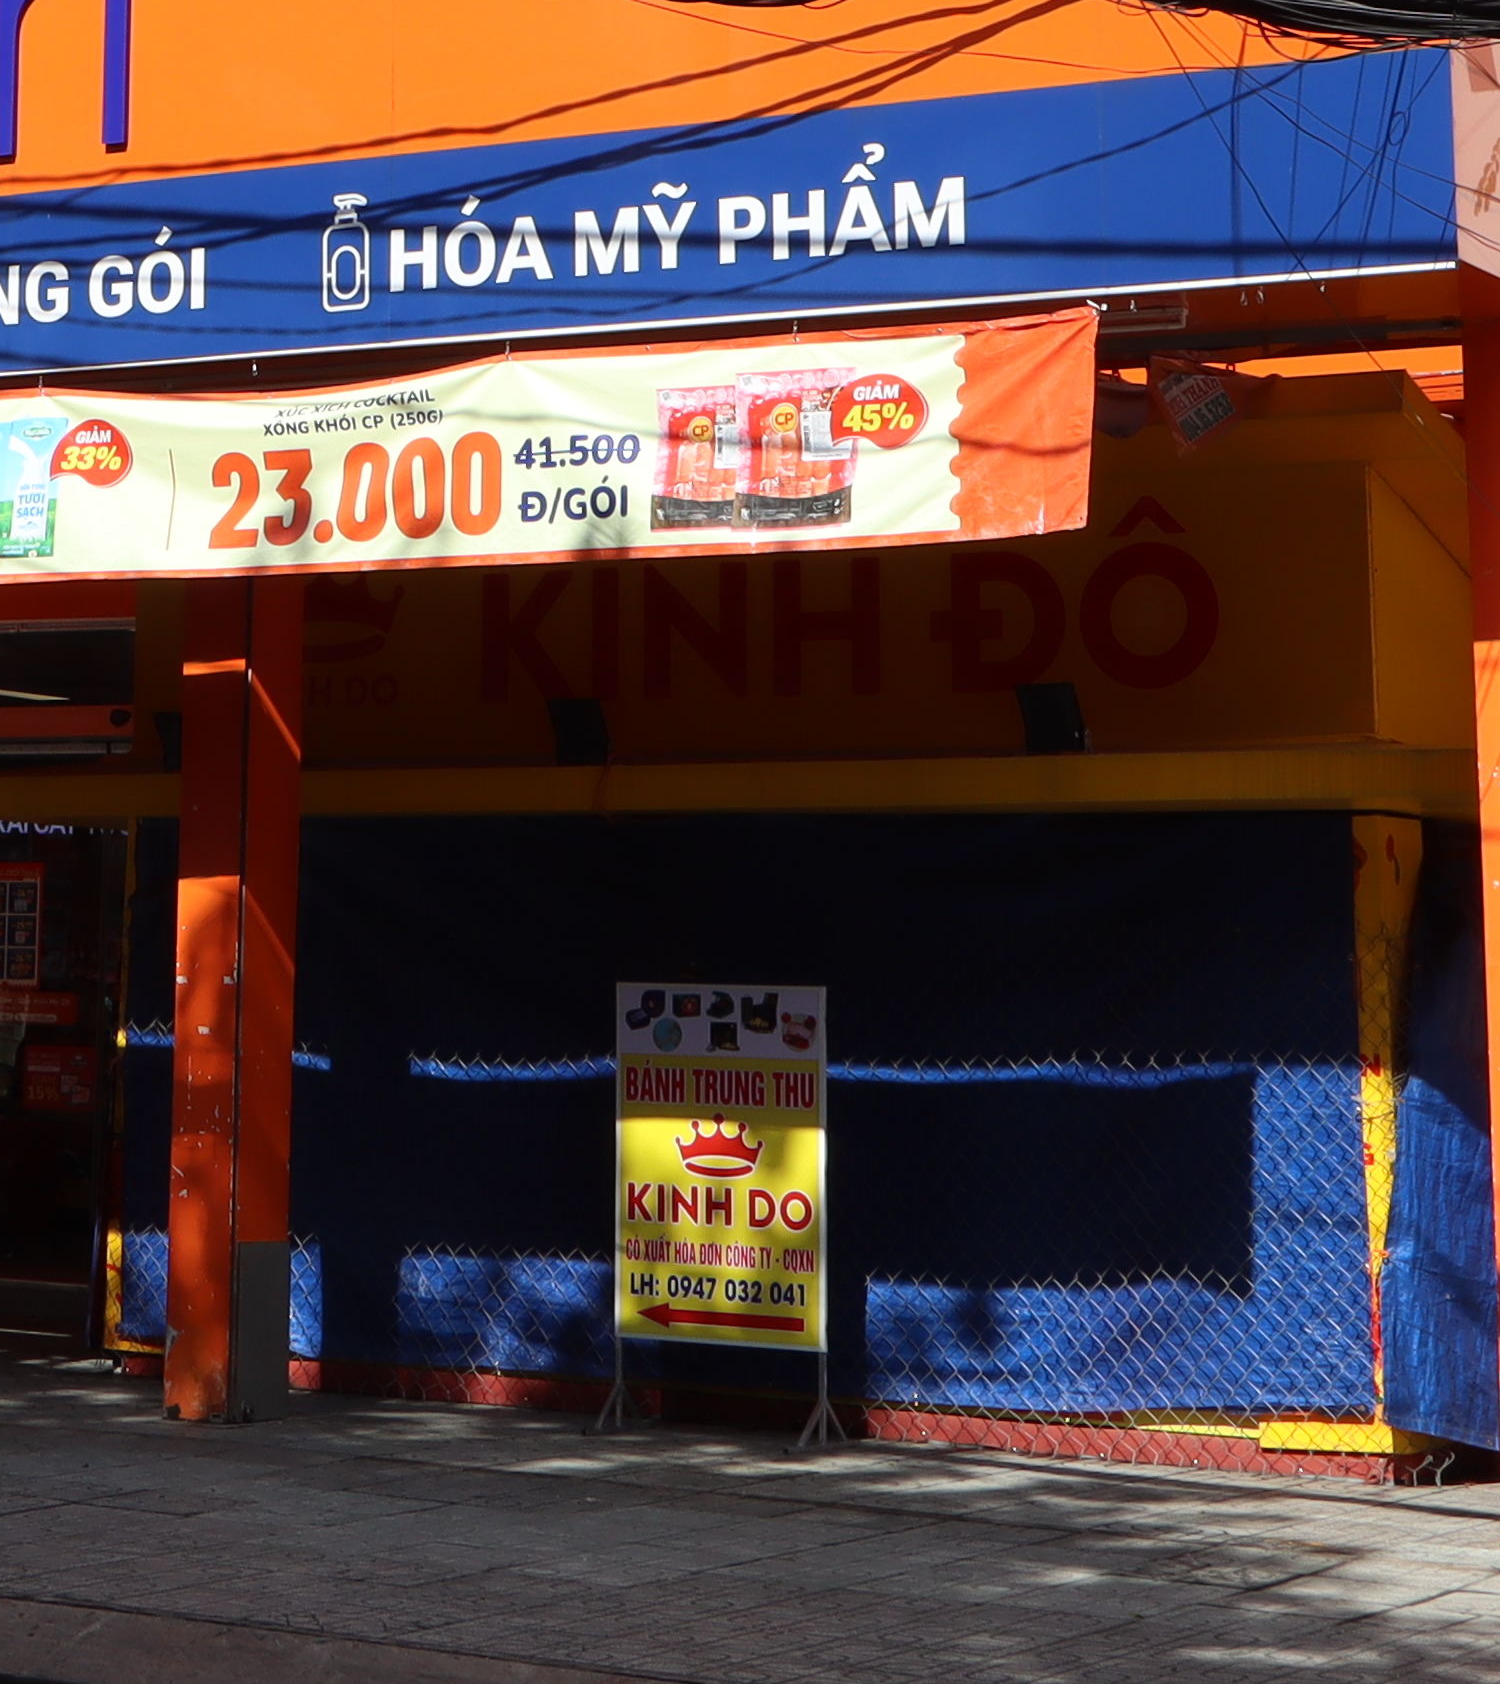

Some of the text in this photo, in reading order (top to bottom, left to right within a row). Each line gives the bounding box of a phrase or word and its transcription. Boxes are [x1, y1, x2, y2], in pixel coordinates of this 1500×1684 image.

[388, 143, 967, 293] HÓA MỸ PHẨM
[87, 224, 206, 319] GÓI
[852, 379, 901, 403] GIẢM
[263, 408, 444, 438] XÔNG KHÓI CP (250G)
[692, 423, 710, 438] CP
[774, 407, 795, 425] CP
[842, 401, 915, 432] 45%
[74, 426, 114, 446] GIẢM
[58, 445, 123, 472] 33%
[208, 431, 642, 549] 23.000 41.500 Đ/GÓI
[479, 494, 1222, 705] KINH ĐÔ
[625, 1060, 816, 1110] BÁNH TRUNG THU
[626, 1182, 814, 1233] KINH DO
[625, 1230, 815, 1274] CÓ XUẤT HÓA ĐƠN CÔNG TY CQXN
[630, 1272, 807, 1308] LH: 0947 032 041
